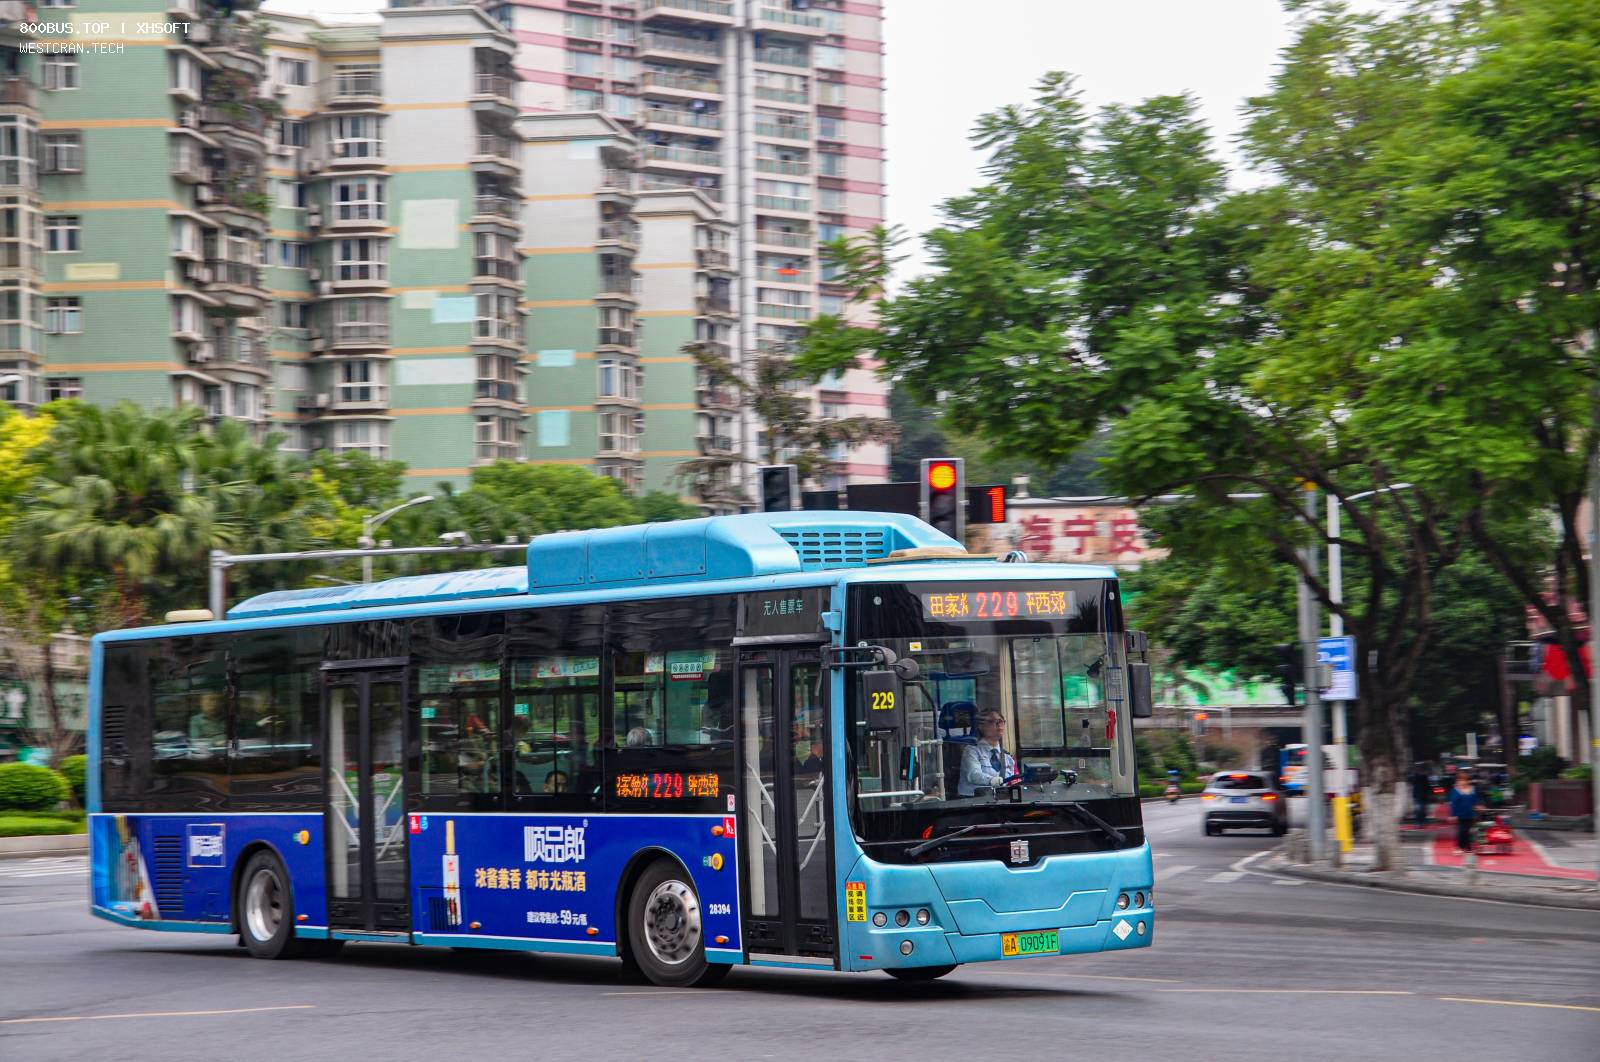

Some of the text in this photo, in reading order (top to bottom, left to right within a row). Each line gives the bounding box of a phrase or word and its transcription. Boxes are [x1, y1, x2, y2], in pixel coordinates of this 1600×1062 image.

[763, 599, 803, 616] 无人售票车
[975, 591, 1019, 617] 229
[871, 691, 895, 710] 229
[652, 772, 684, 798] 229
[524, 824, 585, 863] 顺品郎
[475, 867, 586, 892] 浓酱兼香 都市光瓶酒
[709, 903, 731, 915] 28394
